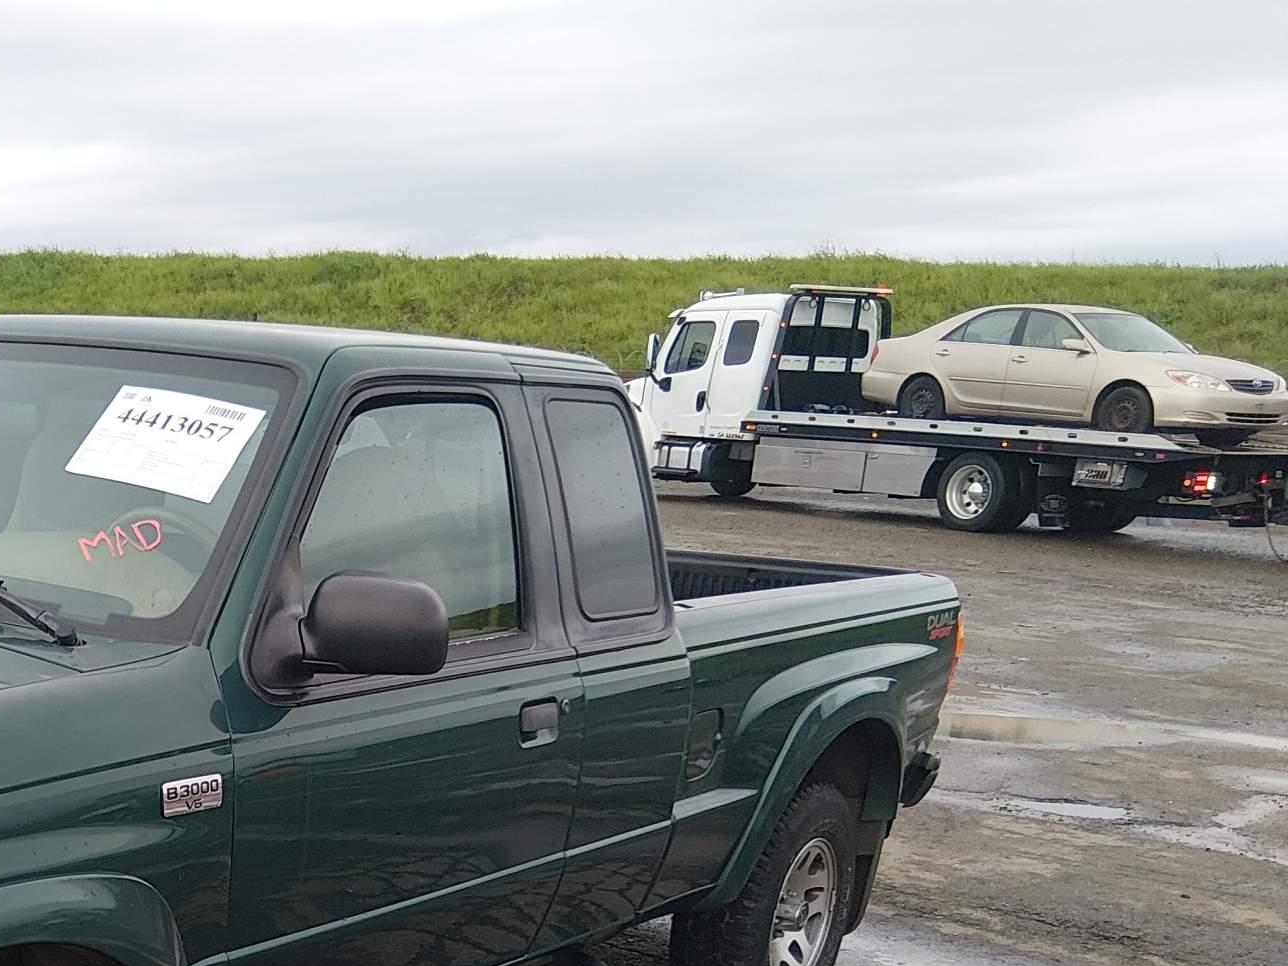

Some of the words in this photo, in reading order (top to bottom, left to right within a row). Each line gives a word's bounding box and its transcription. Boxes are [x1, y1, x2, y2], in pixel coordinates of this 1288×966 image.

[117, 407, 234, 443] 44413057
[77, 518, 163, 563] MAD
[927, 611, 956, 631] DUAL
[166, 779, 219, 801] B3000
[185, 798, 203, 810] V6
